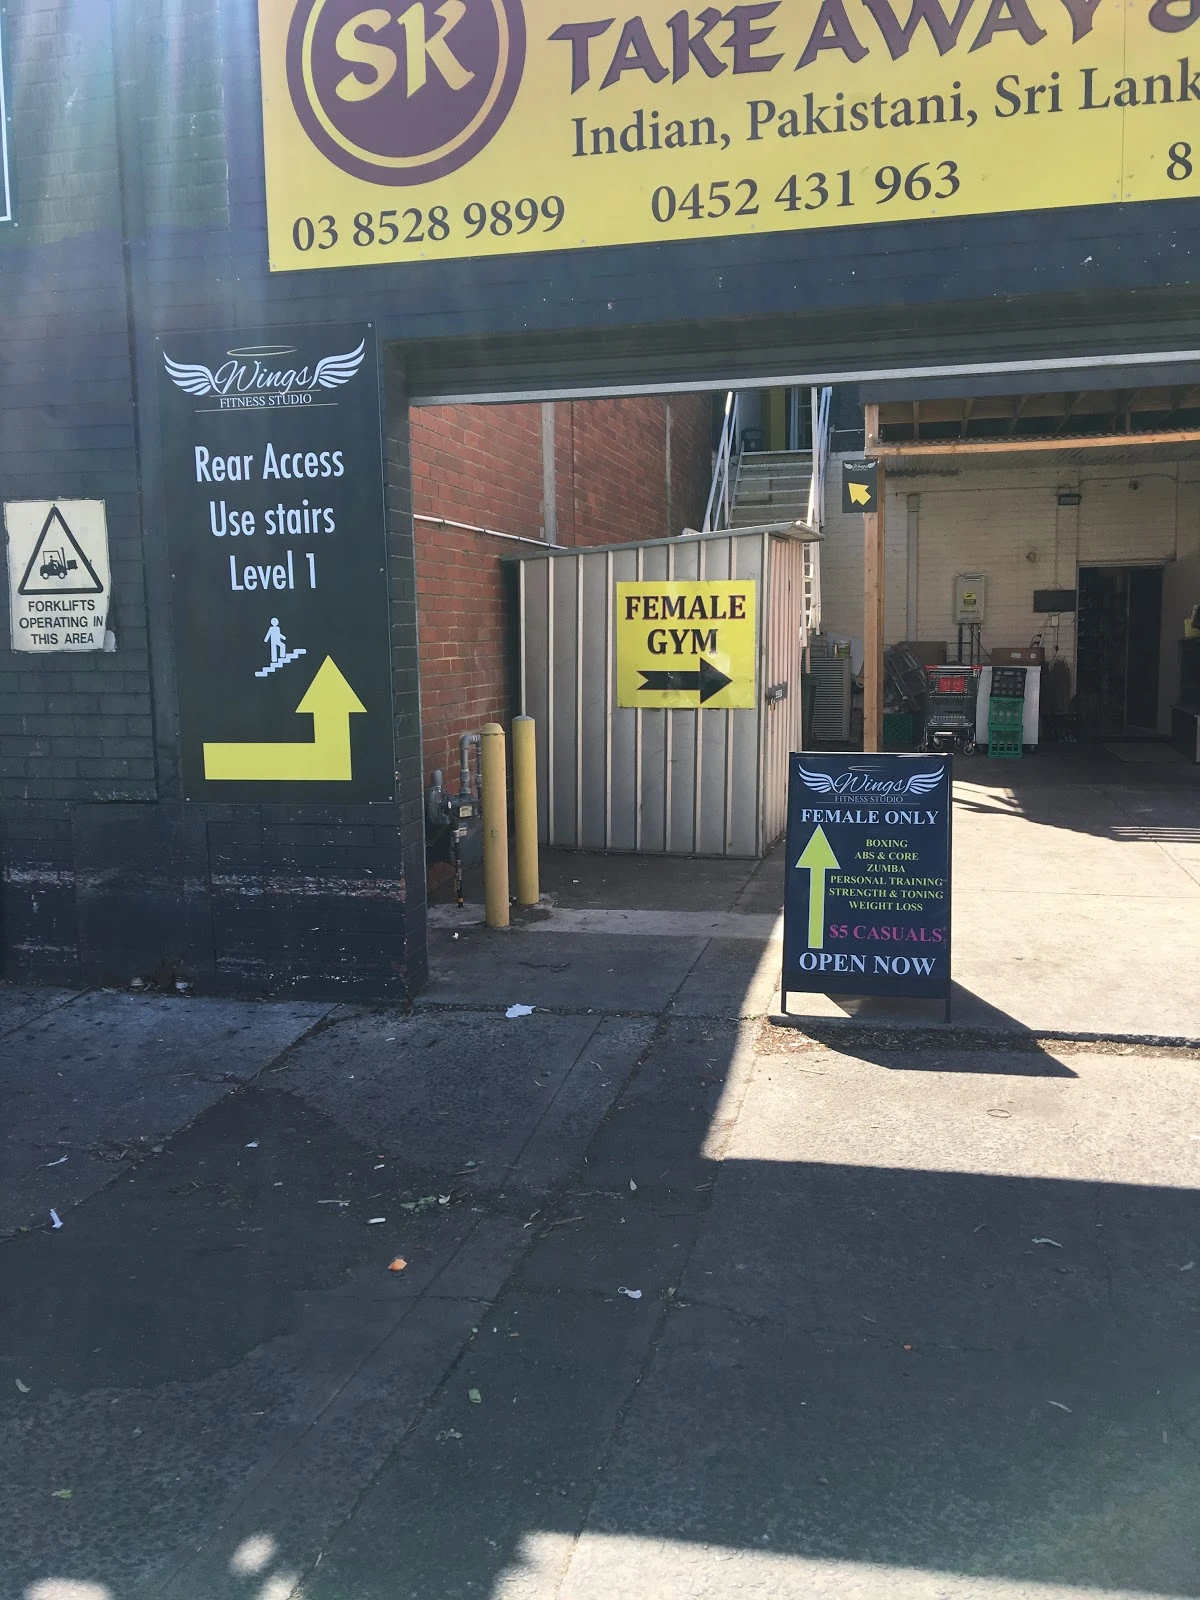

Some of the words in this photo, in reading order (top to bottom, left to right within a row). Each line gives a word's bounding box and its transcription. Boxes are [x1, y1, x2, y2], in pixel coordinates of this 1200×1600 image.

[334, 0, 476, 102] SK
[572, 108, 731, 157] Indian,
[746, 80, 979, 142] Pakistani,
[994, 71, 1061, 118] Sri
[651, 177, 760, 223] 0452
[774, 169, 855, 212] 431
[874, 159, 961, 205] 963
[292, 214, 340, 251] 03
[352, 204, 451, 247] 8528
[463, 194, 566, 239] 9899
[214, 360, 312, 395] Wings
[219, 396, 266, 408] FITNESS
[268, 393, 312, 406] STUDIO
[194, 445, 253, 483] Rear
[262, 442, 345, 480] Access
[209, 500, 256, 537] Use
[264, 499, 336, 535] stairs
[230, 550, 294, 591] Level
[305, 552, 317, 589] 1
[28, 600, 96, 612] FORKLIFTS
[625, 595, 746, 620] FEMALE
[19, 617, 88, 629] OPERATING
[93, 616, 104, 627] IN
[31, 633, 58, 645] THIS
[64, 632, 95, 645] AREA
[647, 628, 719, 655] GYM
[835, 773, 906, 797] Wings
[835, 795, 869, 803] FITNESS
[870, 796, 904, 804] STUDIO
[801, 808, 880, 825] FEMALE
[884, 810, 940, 826] ONLY
[866, 838, 908, 849] BOXING
[855, 851, 875, 861] ABS
[877, 852, 886, 861] &
[888, 852, 919, 862] CORE
[867, 863, 906, 874] ZUMBA
[830, 875, 887, 886] PERSONAL
[889, 877, 944, 888] TRAINING
[829, 888, 887, 899] STRENGTH
[889, 889, 898, 899] &
[900, 890, 945, 901] TONING
[849, 901, 894, 911] WEIGHT
[896, 903, 923, 912] LOSS
[829, 924, 849, 940] $5
[853, 925, 943, 943] CASUALS
[799, 952, 866, 973] OPEN
[873, 955, 937, 976] NOW
